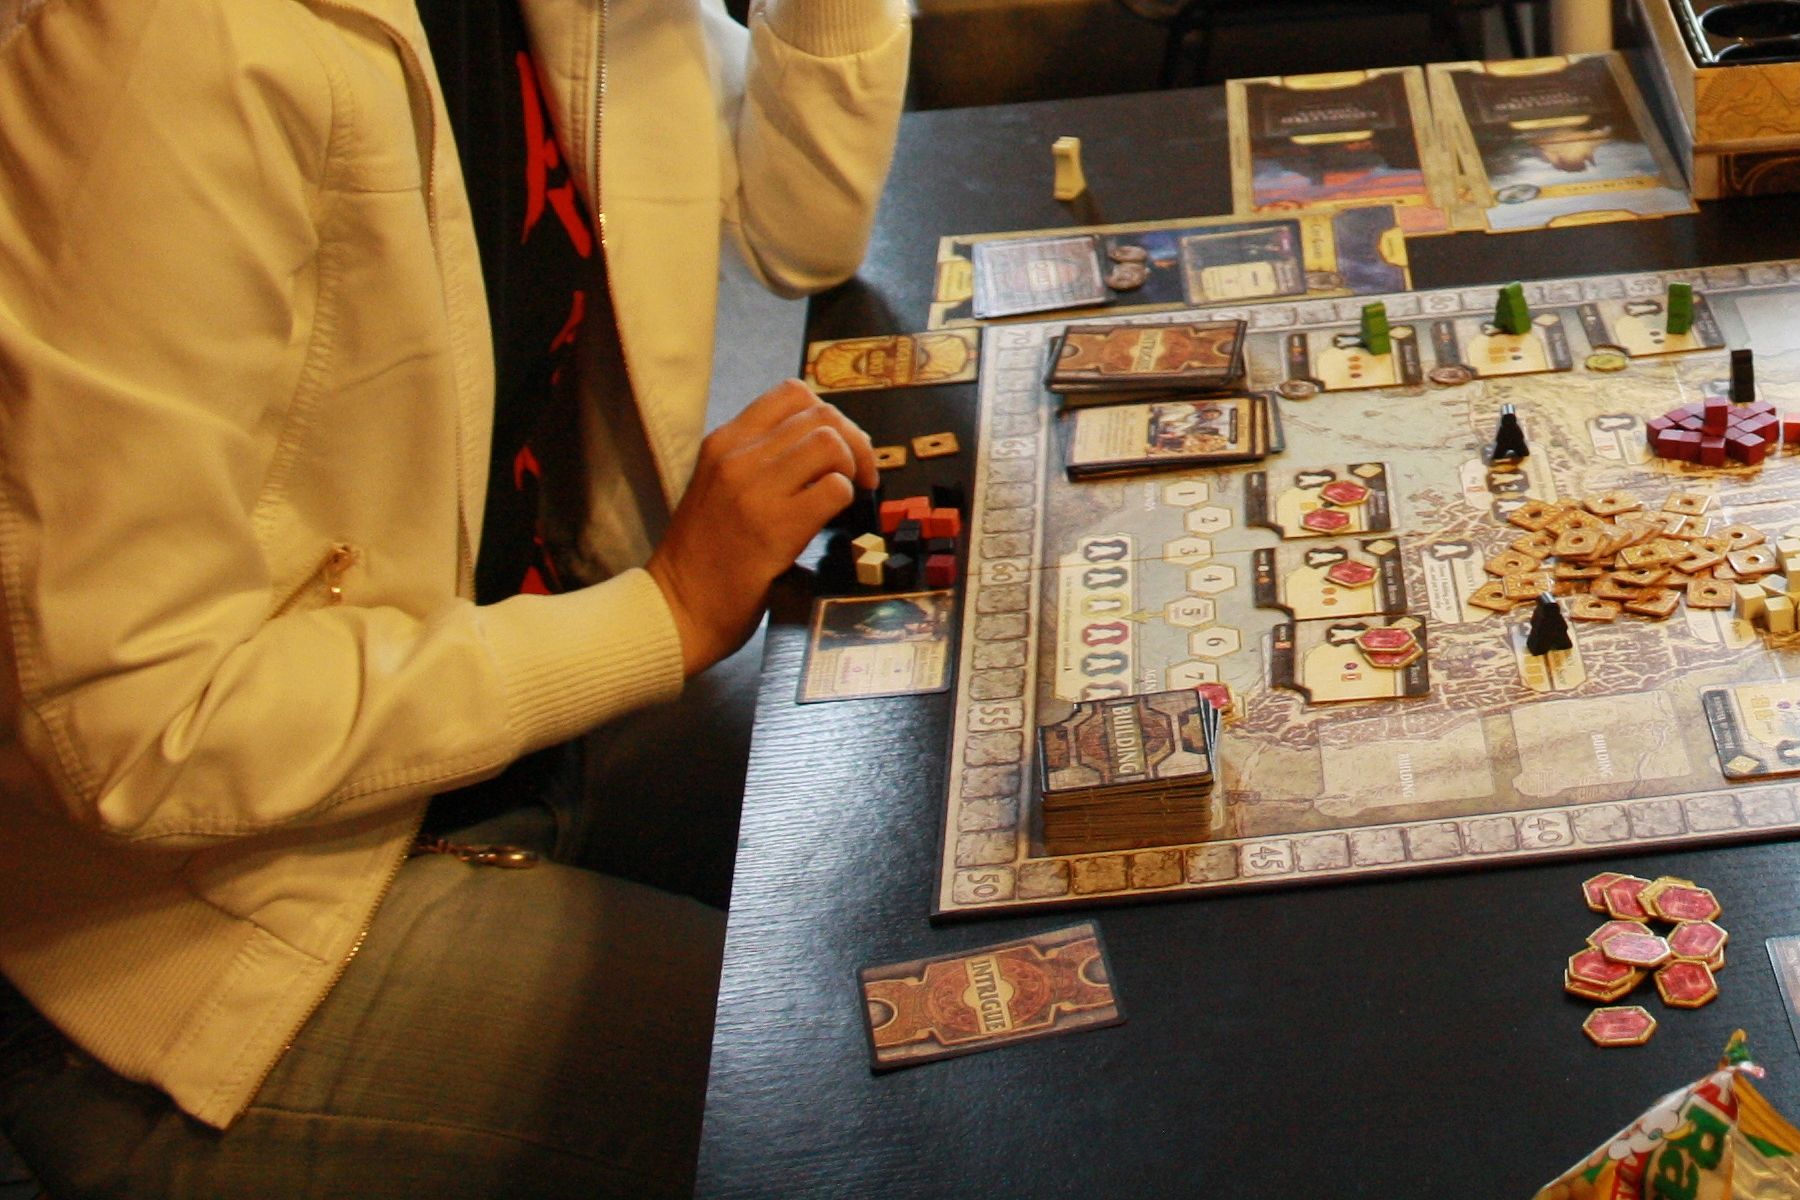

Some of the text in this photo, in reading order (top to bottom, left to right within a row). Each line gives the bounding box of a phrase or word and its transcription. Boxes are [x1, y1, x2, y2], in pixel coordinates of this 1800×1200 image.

[1000, 438, 1029, 457] 65
[1201, 515, 1219, 524] 2
[1179, 546, 1199, 556] 3
[990, 561, 1013, 582] 60
[1202, 574, 1222, 583] 4
[1181, 607, 1201, 617] 5
[1206, 636, 1227, 647] 6
[1184, 671, 1205, 680] 7
[978, 705, 1011, 728] 55
[1111, 705, 1141, 775] BUILDING
[1589, 733, 1615, 779] BUILDING
[1398, 752, 1417, 799] BUILDING
[1527, 816, 1564, 843] 40
[1249, 846, 1285, 869] 45
[967, 872, 999, 898] 50
[970, 958, 1006, 1032] INTRIGUE
